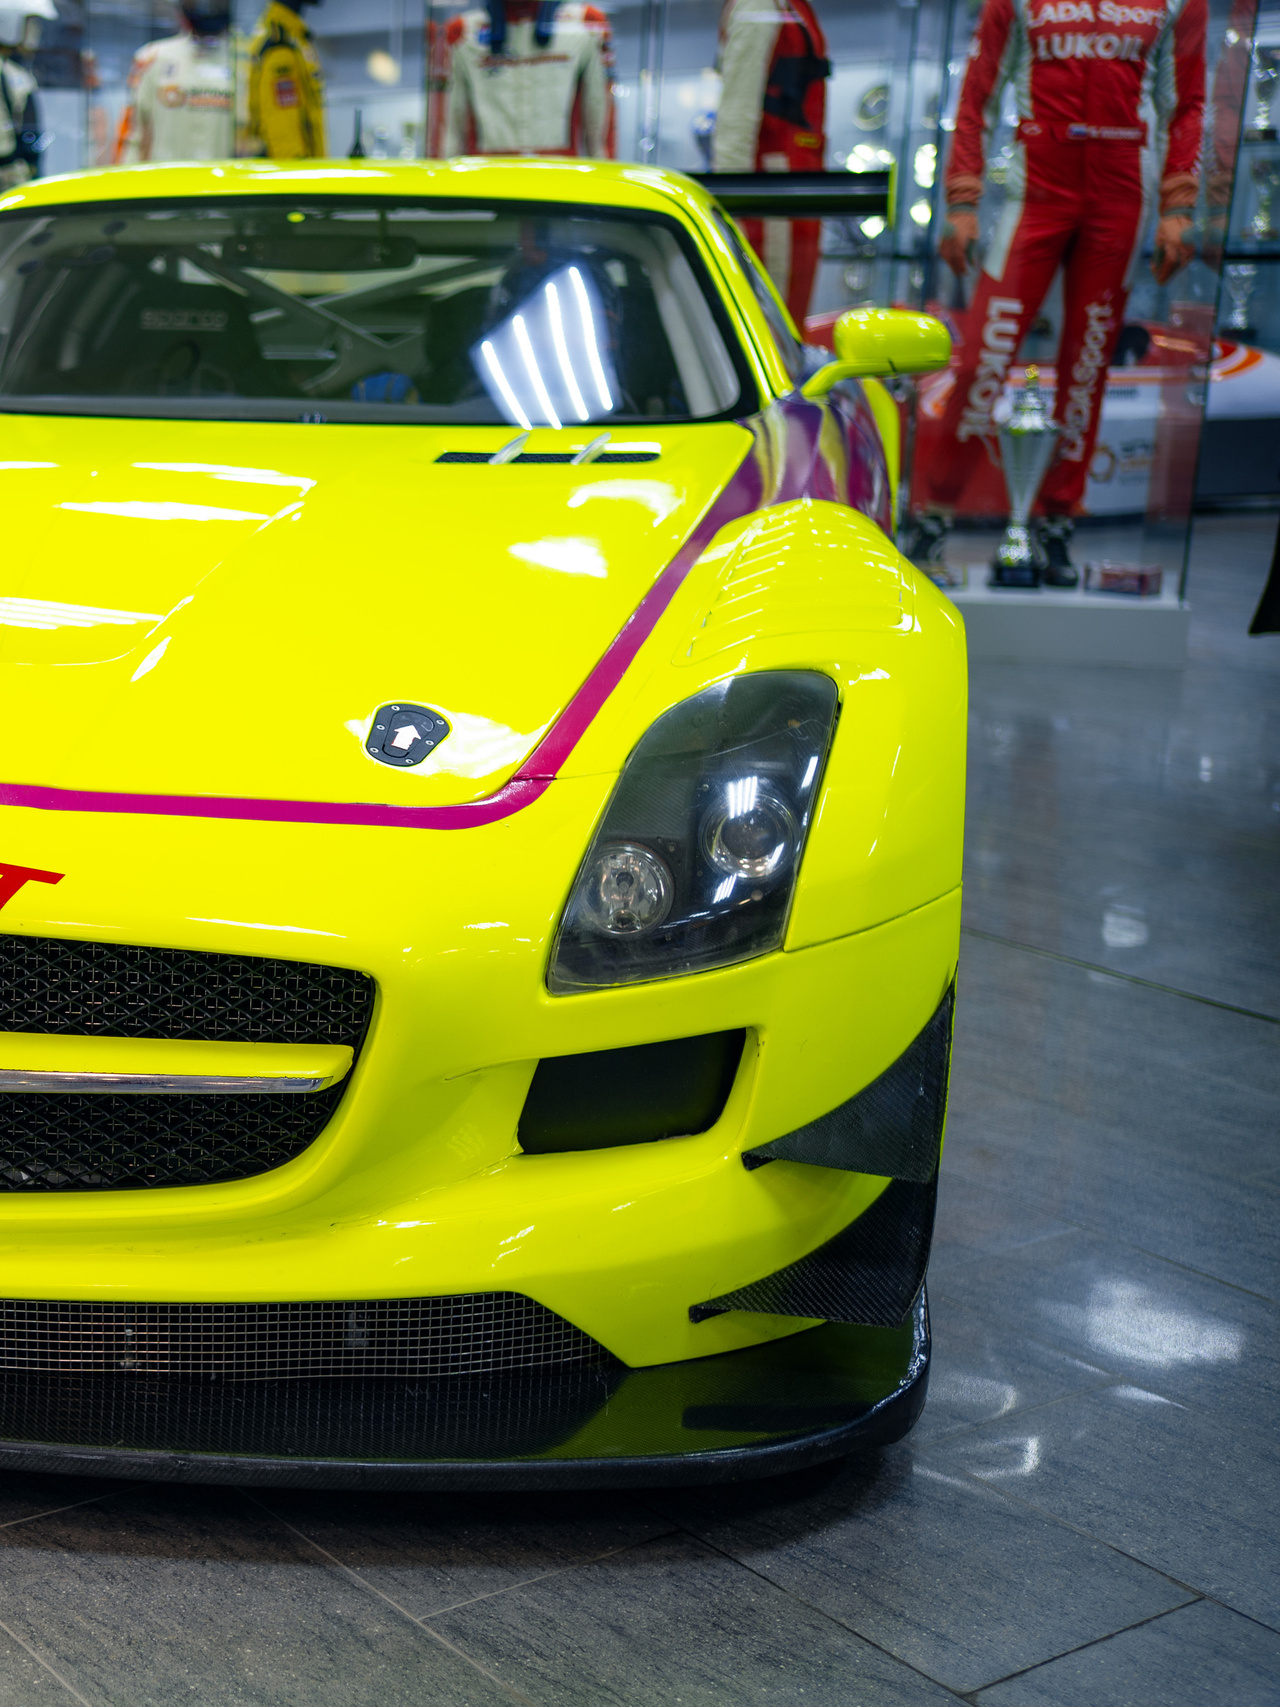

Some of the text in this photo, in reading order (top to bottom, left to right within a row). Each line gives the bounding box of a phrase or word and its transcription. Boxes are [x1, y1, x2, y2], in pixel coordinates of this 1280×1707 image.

[1027, 0, 1166, 29] LADA Sport
[1036, 32, 1144, 61] LUKOIL
[956, 296, 1024, 443] LUKOIL
